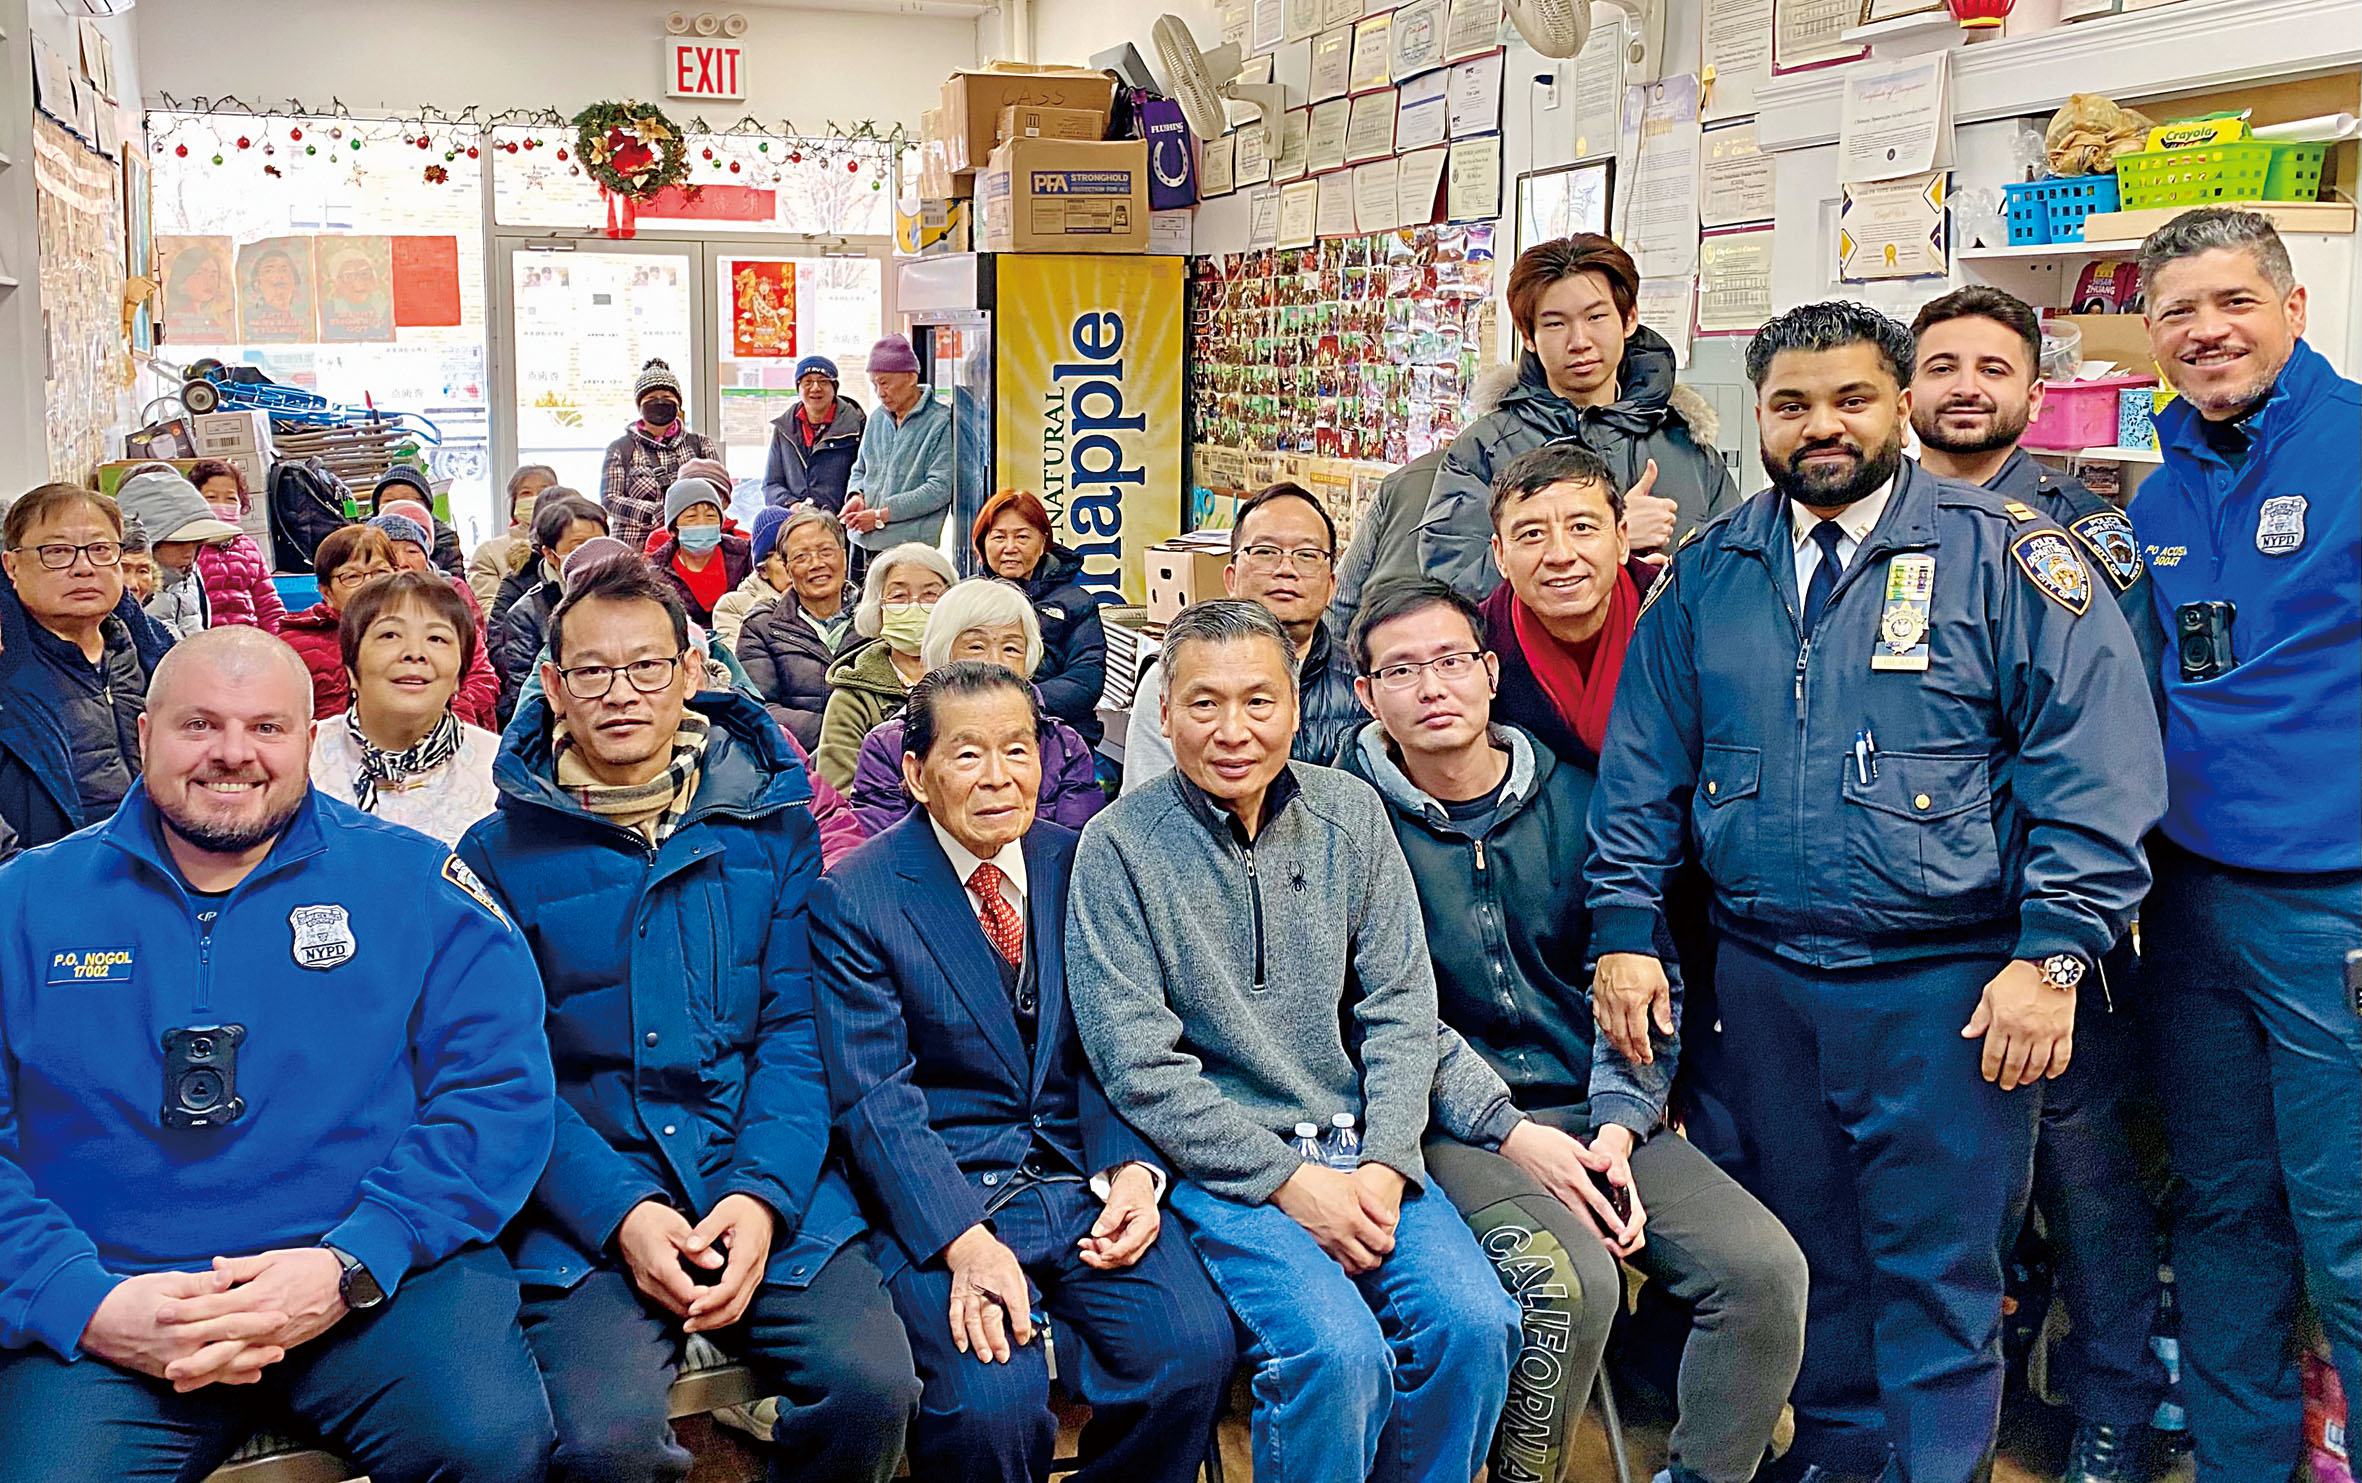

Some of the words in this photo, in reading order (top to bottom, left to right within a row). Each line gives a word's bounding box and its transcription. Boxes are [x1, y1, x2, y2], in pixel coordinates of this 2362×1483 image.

[677, 46, 740, 94] EXIT
[1001, 84, 1066, 106] CASS
[1151, 122, 1184, 133] FLUSHING
[2166, 127, 2213, 141] Crayola
[1034, 174, 1068, 193] PFA
[1070, 174, 1129, 182] STRONGHOLD
[2092, 278, 2113, 286] SUSAN
[2086, 285, 2116, 295] ZHUANG
[1044, 386, 1065, 532] NATURAL
[1053, 311, 1146, 605] napple
[2088, 517, 2121, 527] POLICE
[2029, 536, 2058, 551] POLICE
[2263, 535, 2295, 546] NYPD
[2027, 543, 2072, 568] DEPARTMENT
[2145, 545, 2160, 555] PO
[2093, 544, 2112, 562] CITY
[2110, 564, 2120, 576] OF
[2153, 555, 2181, 567] 30047
[2037, 573, 2057, 590] CITY
[2058, 590, 2071, 600] OF
[54, 953, 78, 967] P.O.
[84, 952, 133, 966] NOGOL
[305, 944, 346, 960] NYPD
[73, 965, 109, 977] 17002
[1481, 1225, 1571, 1483] CALIFORNIA
